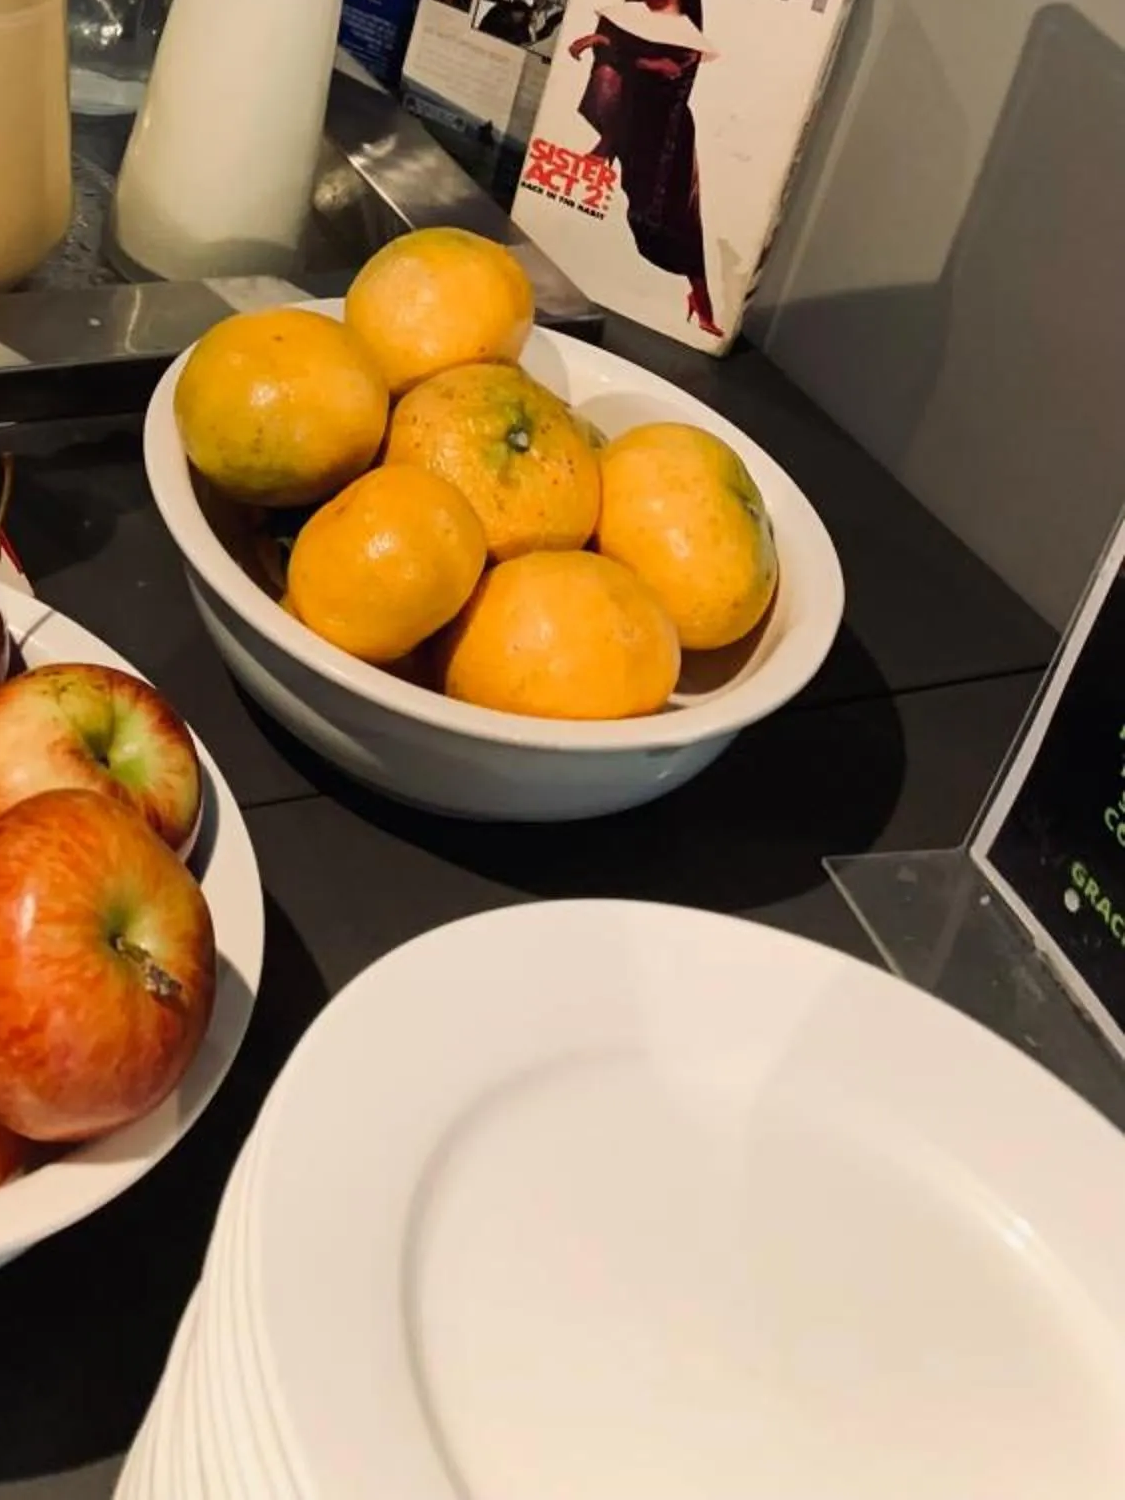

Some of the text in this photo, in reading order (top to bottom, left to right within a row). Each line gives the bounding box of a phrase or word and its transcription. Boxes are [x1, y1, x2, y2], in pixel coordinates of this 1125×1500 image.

[525, 162, 579, 196] ACT
[530, 138, 616, 192] SISTER
[1071, 861, 1125, 946] GRAC
